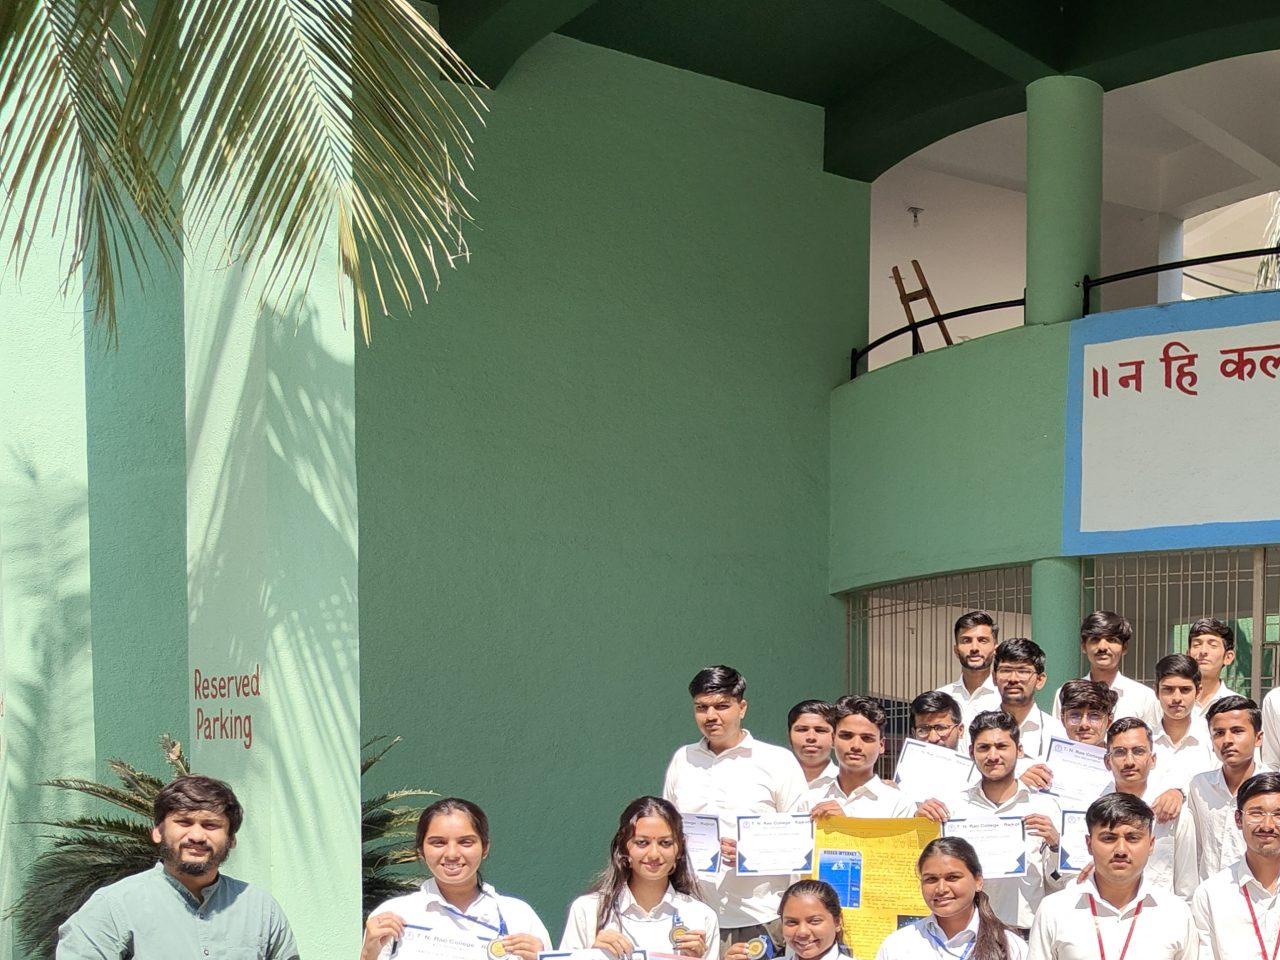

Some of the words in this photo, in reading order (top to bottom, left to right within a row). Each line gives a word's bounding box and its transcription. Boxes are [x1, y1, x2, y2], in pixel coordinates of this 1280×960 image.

[1118, 360, 1145, 393] न
[1160, 341, 1198, 396] हि
[194, 663, 261, 700] Reserved
[196, 707, 253, 750] Parking
